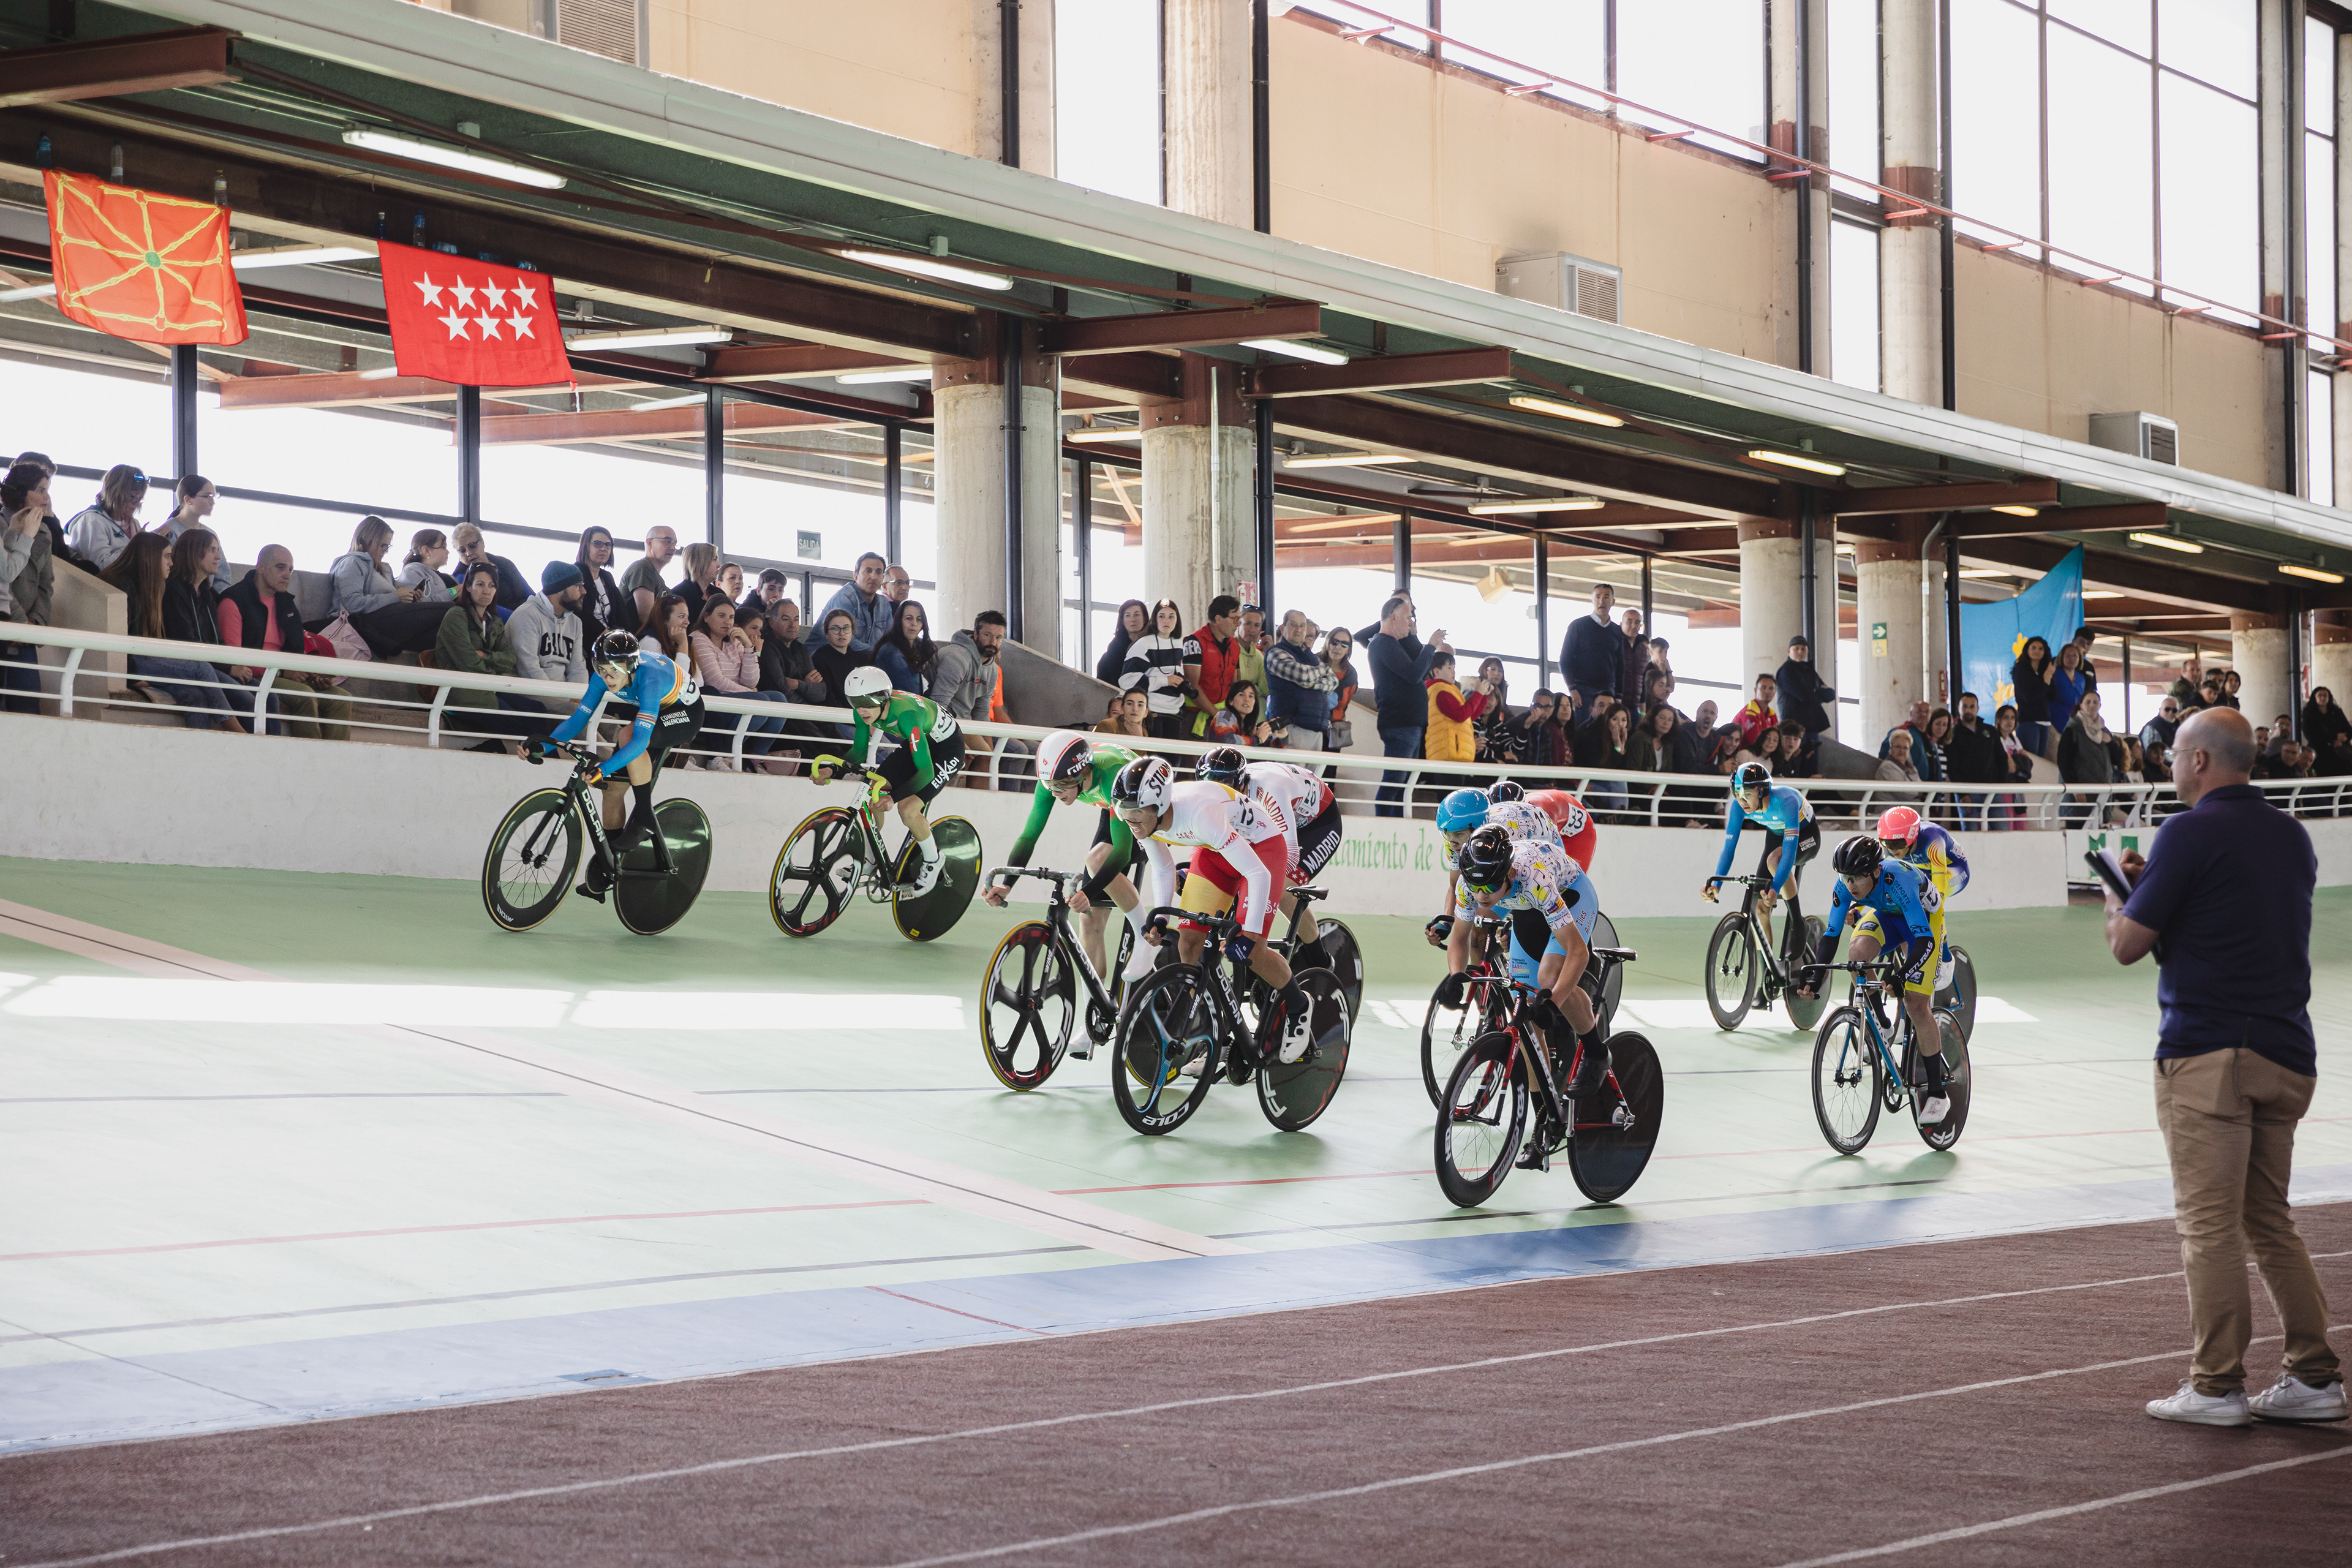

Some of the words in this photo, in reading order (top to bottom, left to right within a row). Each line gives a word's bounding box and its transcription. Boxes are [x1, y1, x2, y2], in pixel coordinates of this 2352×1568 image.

[798, 538, 820, 550] SALIDA
[660, 710, 687, 722] COMUNITAT
[662, 716, 690, 728] VALENCIANA
[930, 756, 960, 790] EUSKADI
[1304, 779, 1317, 807] 26
[582, 788, 605, 843] DOLAN
[1262, 791, 1289, 833] MADRID
[1568, 807, 1584, 829] 33
[1302, 830, 1340, 874] MADRID
[1414, 827, 1433, 872] de
[1893, 880, 1911, 905] DEPORTE
[497, 903, 514, 922] MICHE
[1575, 910, 1587, 927] Illes
[1118, 932, 1131, 963] DF4
[1905, 940, 1933, 980] ASTURIAS
[1189, 994, 1201, 1019] WING
[1216, 963, 1243, 1025] DOLAN
[1142, 1101, 1190, 1127] COLE
